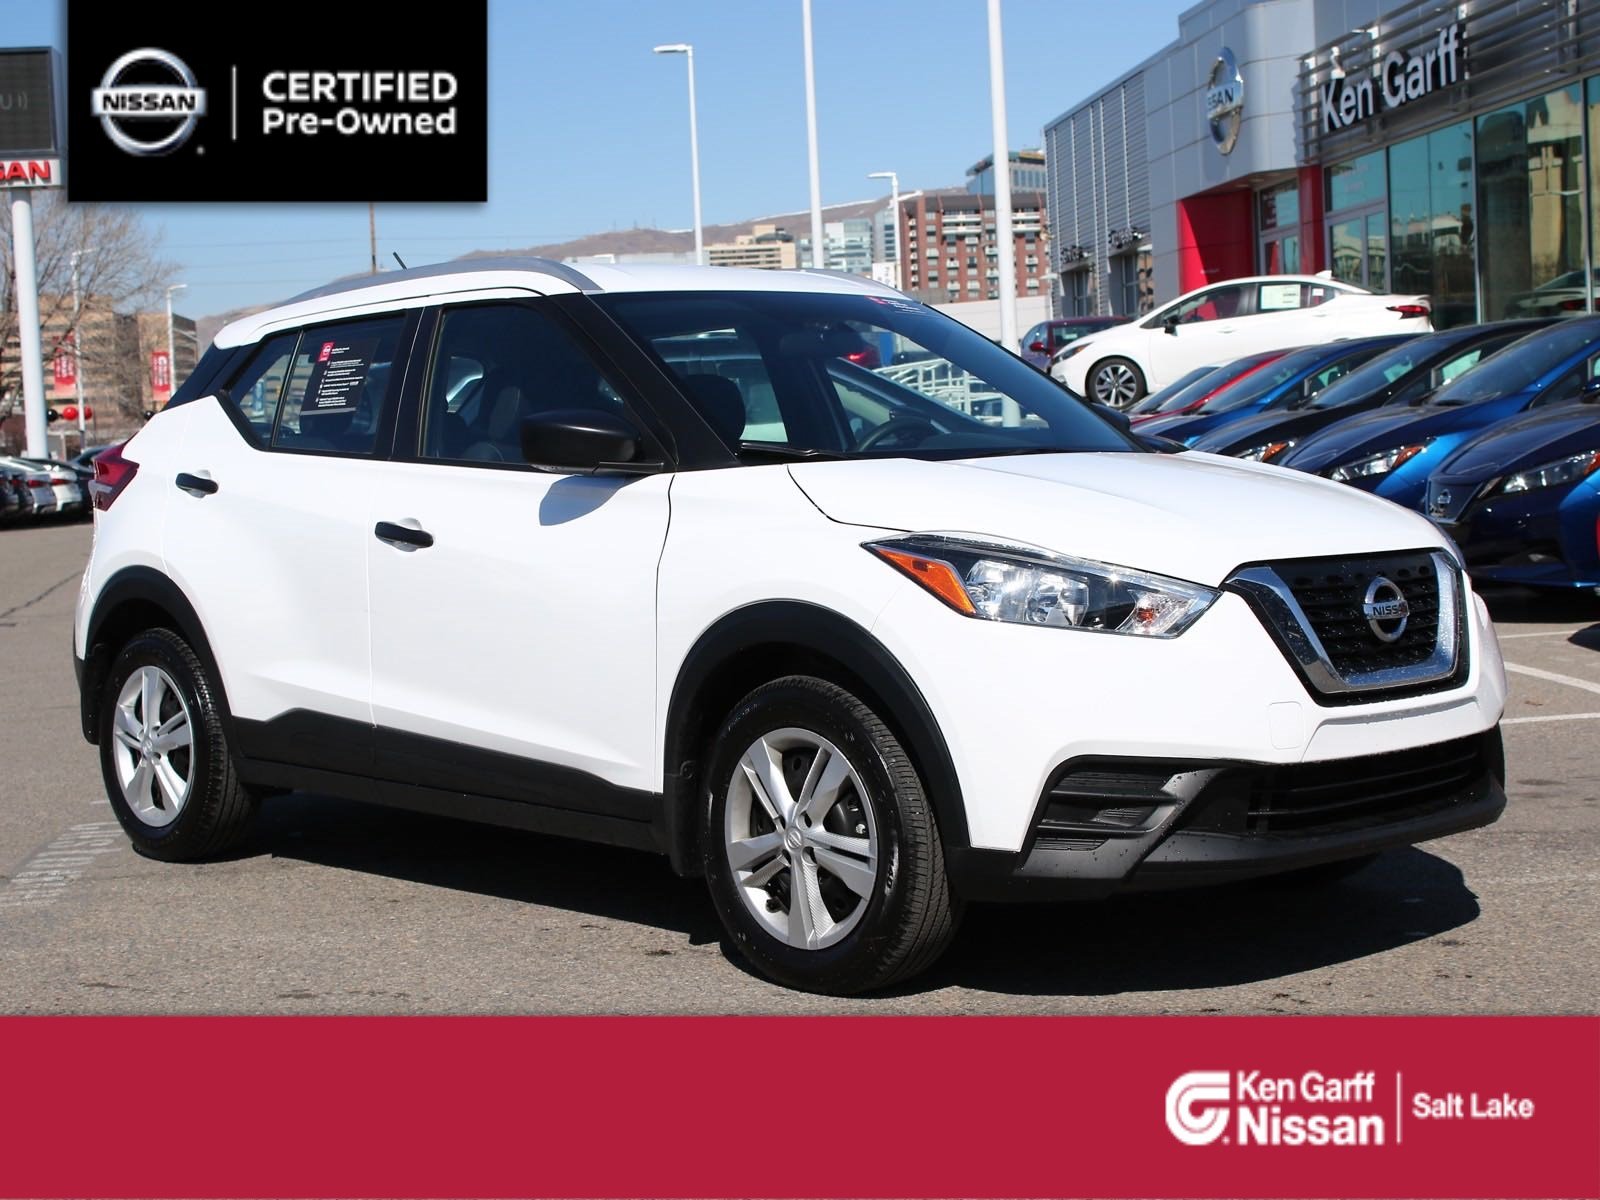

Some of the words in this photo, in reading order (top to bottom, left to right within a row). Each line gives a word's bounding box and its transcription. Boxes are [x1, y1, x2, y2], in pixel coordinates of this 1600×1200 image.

[1320, 76, 1374, 134] Ken
[1382, 22, 1459, 108] Garff
[1372, 603, 1402, 617] NISS
